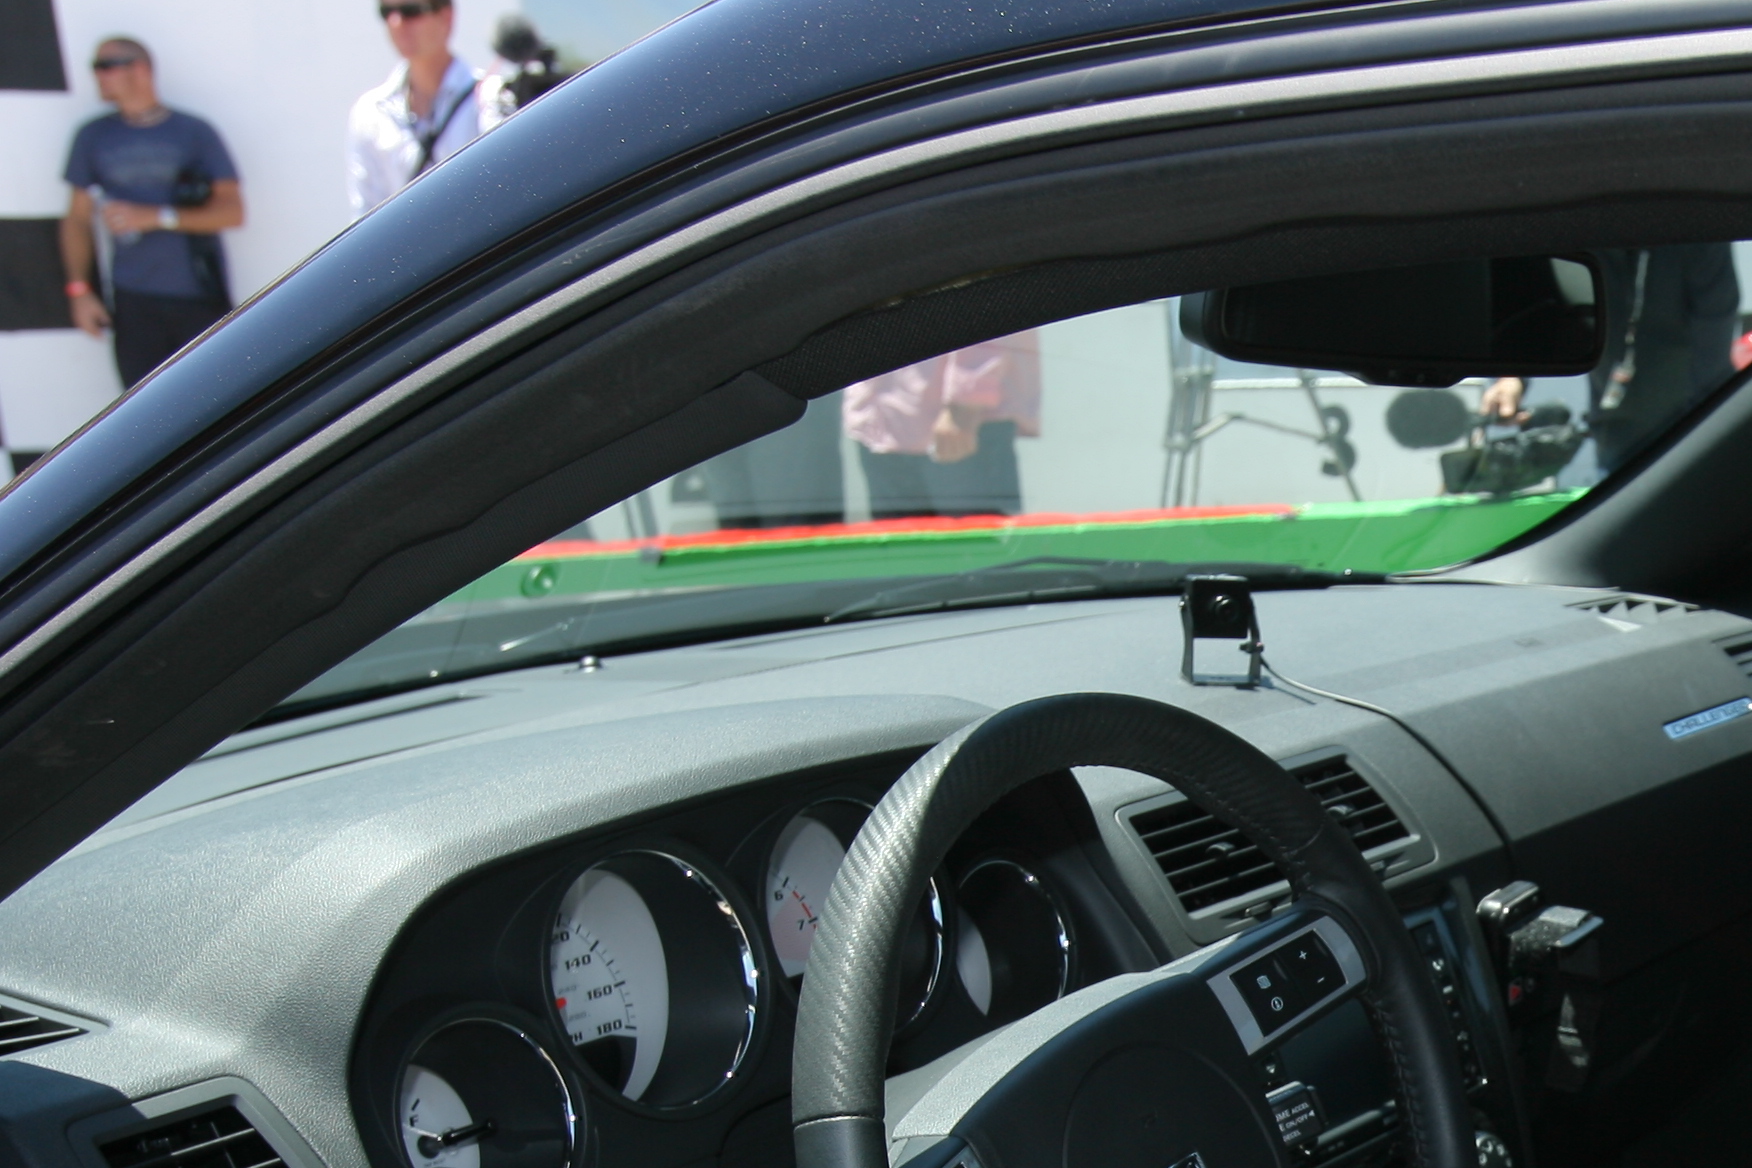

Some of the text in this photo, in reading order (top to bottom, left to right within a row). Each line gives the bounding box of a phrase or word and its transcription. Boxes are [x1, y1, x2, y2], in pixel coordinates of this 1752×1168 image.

[774, 891, 784, 901] 6
[797, 919, 805, 931] 7
[564, 953, 592, 971] 140
[586, 984, 613, 1001] 160
[596, 1018, 623, 1035] 180
[1291, 1102, 1310, 1115] ACCEL
[409, 1114, 419, 1127] F
[1285, 1113, 1309, 1129] ON/OFF
